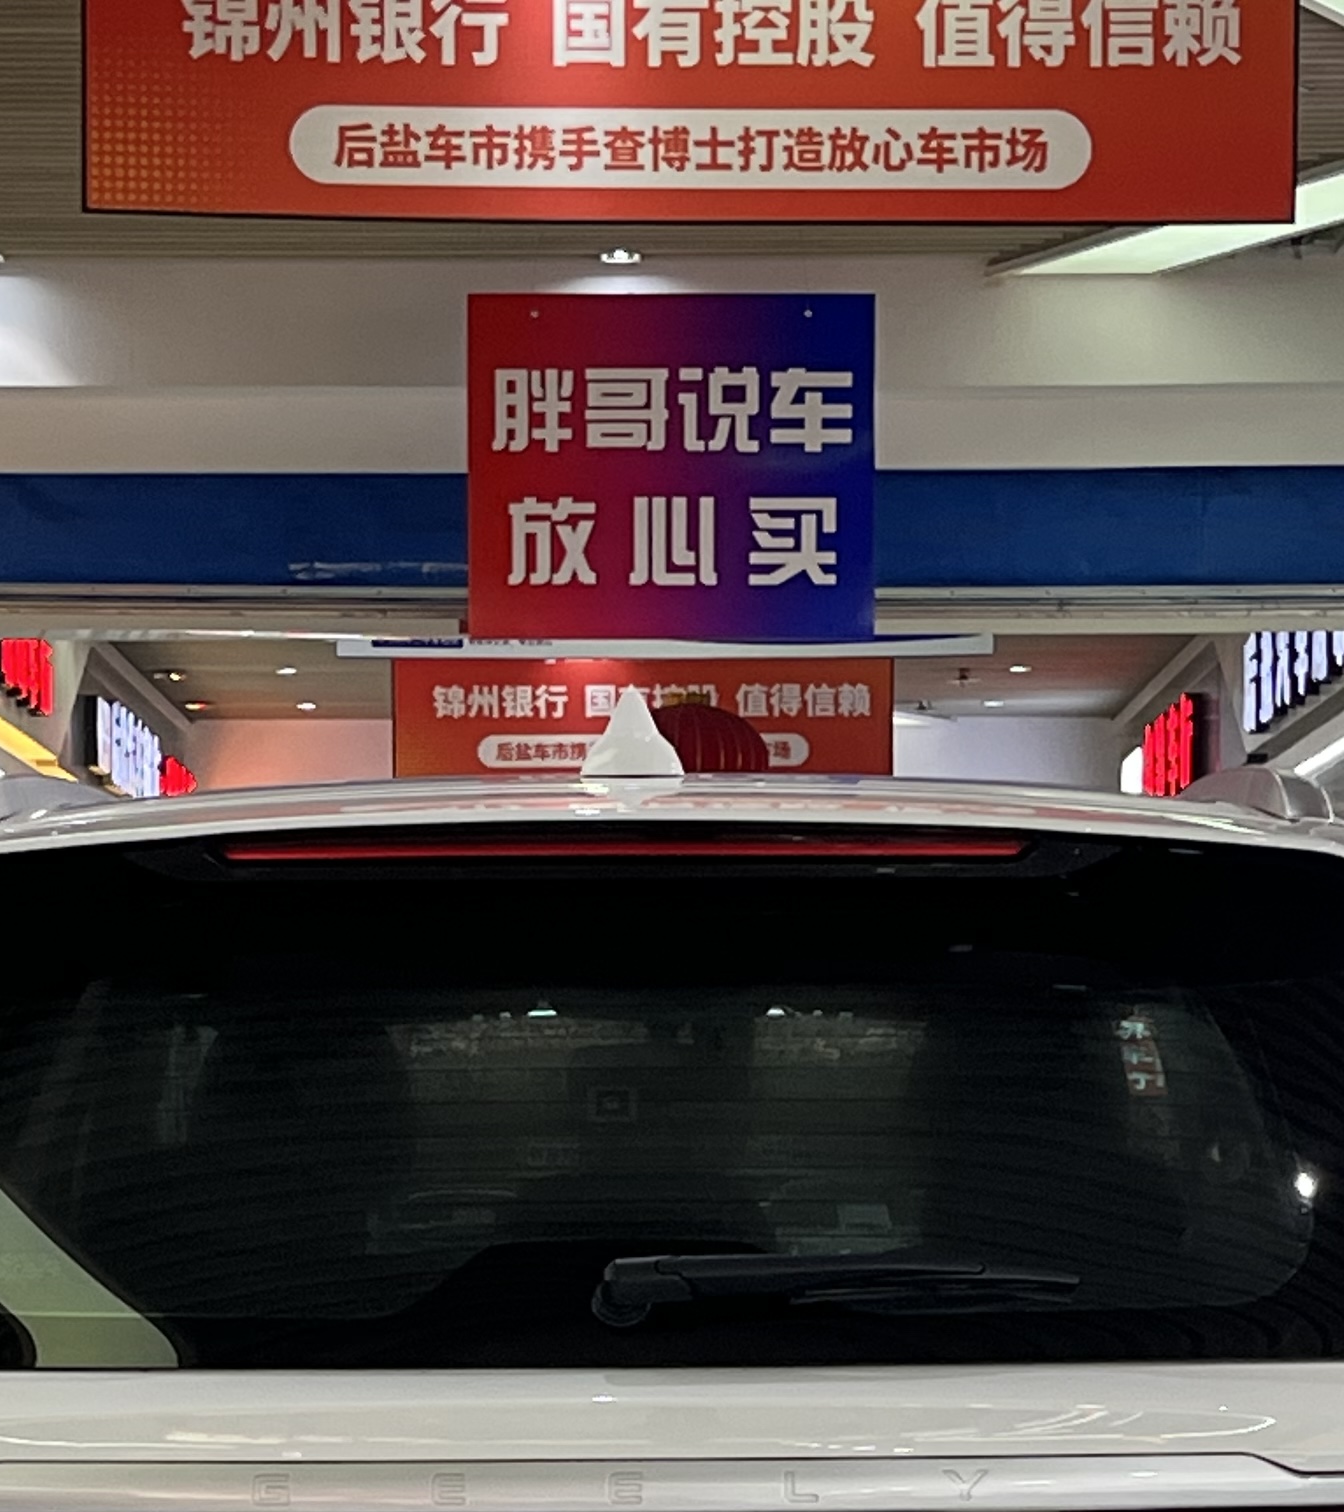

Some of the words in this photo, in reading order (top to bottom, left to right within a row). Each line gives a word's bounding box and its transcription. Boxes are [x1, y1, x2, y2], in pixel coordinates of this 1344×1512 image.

[181, 0, 509, 66] 锦州银行
[551, 0, 875, 68] 国有控股
[914, 0, 1243, 68] 值得信赖
[333, 123, 1049, 174] 后盐车市携手查博士打造放心车市场
[492, 366, 853, 453] 胖哥说车
[507, 496, 838, 586] 放心买
[432, 684, 569, 719] 锦州银行
[735, 683, 872, 718] 值得信赖
[254, 1468, 990, 1506] GEELY
